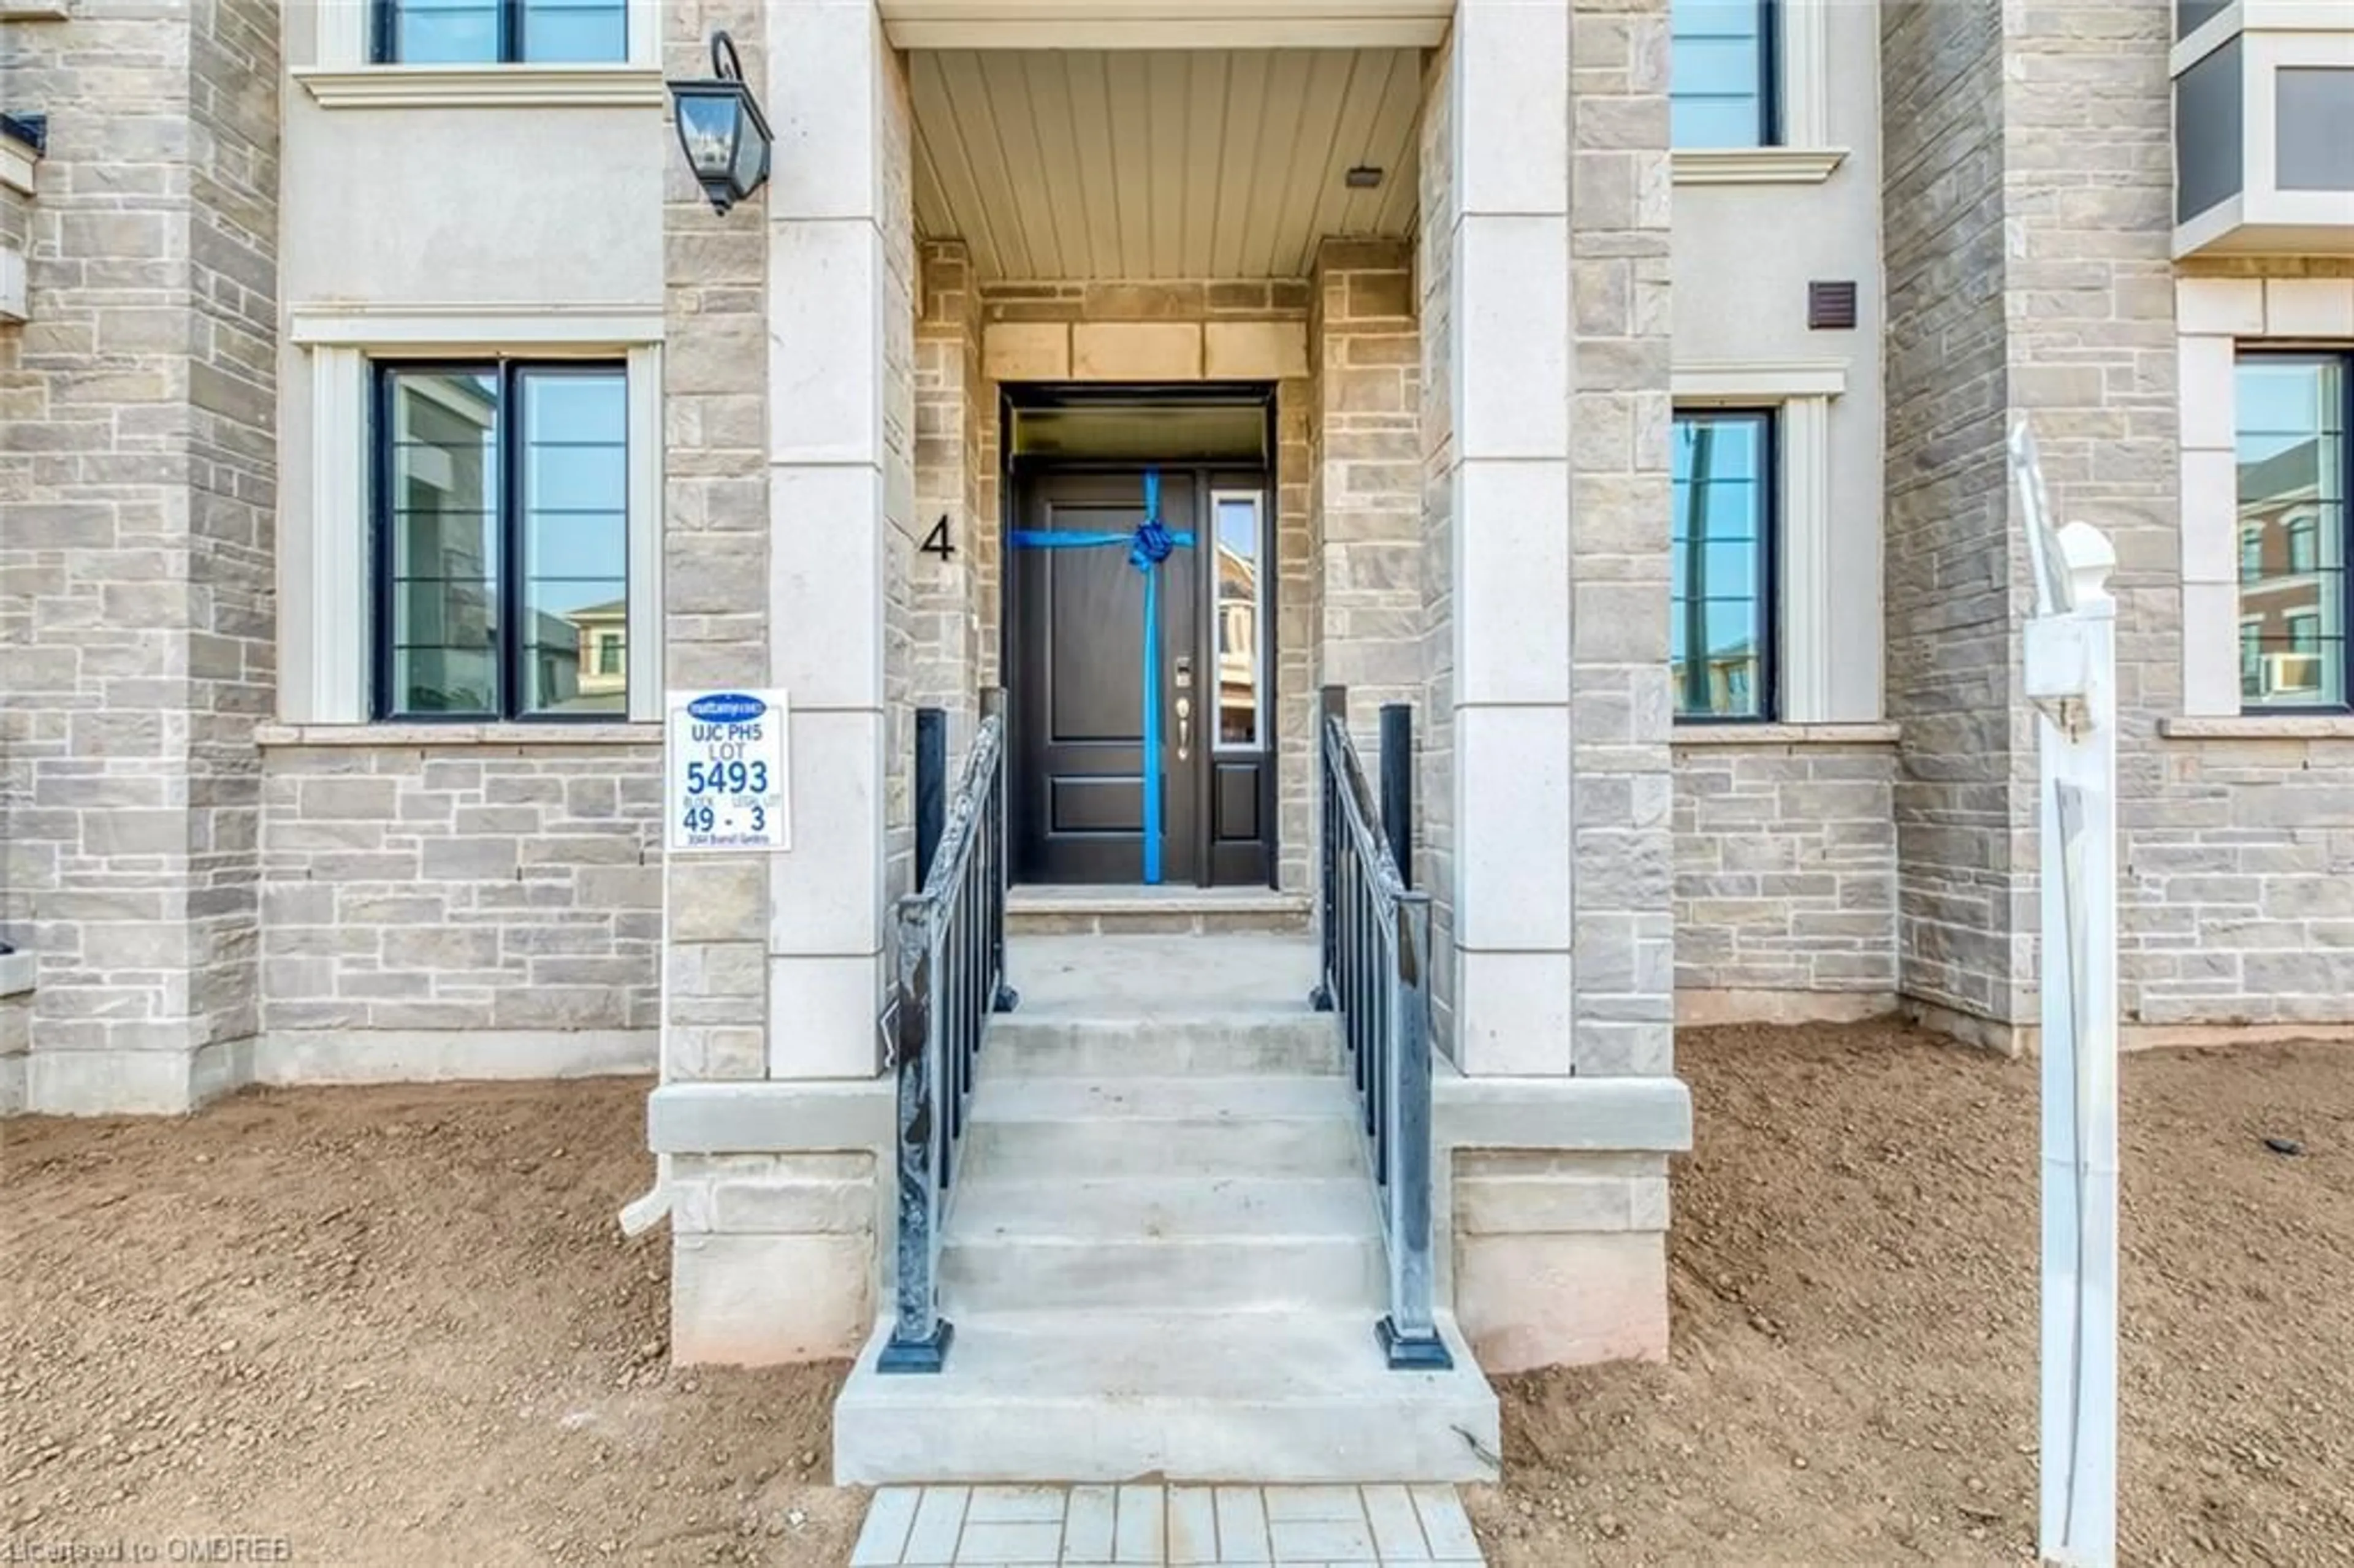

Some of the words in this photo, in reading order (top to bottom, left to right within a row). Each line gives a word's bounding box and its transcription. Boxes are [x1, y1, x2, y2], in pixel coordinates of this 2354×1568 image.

[920, 513, 955, 561] 4
[691, 724, 723, 742] UJC
[728, 724, 764, 741] PH5
[709, 742, 746, 761] LOT
[687, 761, 768, 794] 5493
[683, 807, 714, 832] 49
[751, 806, 765, 831] 3
